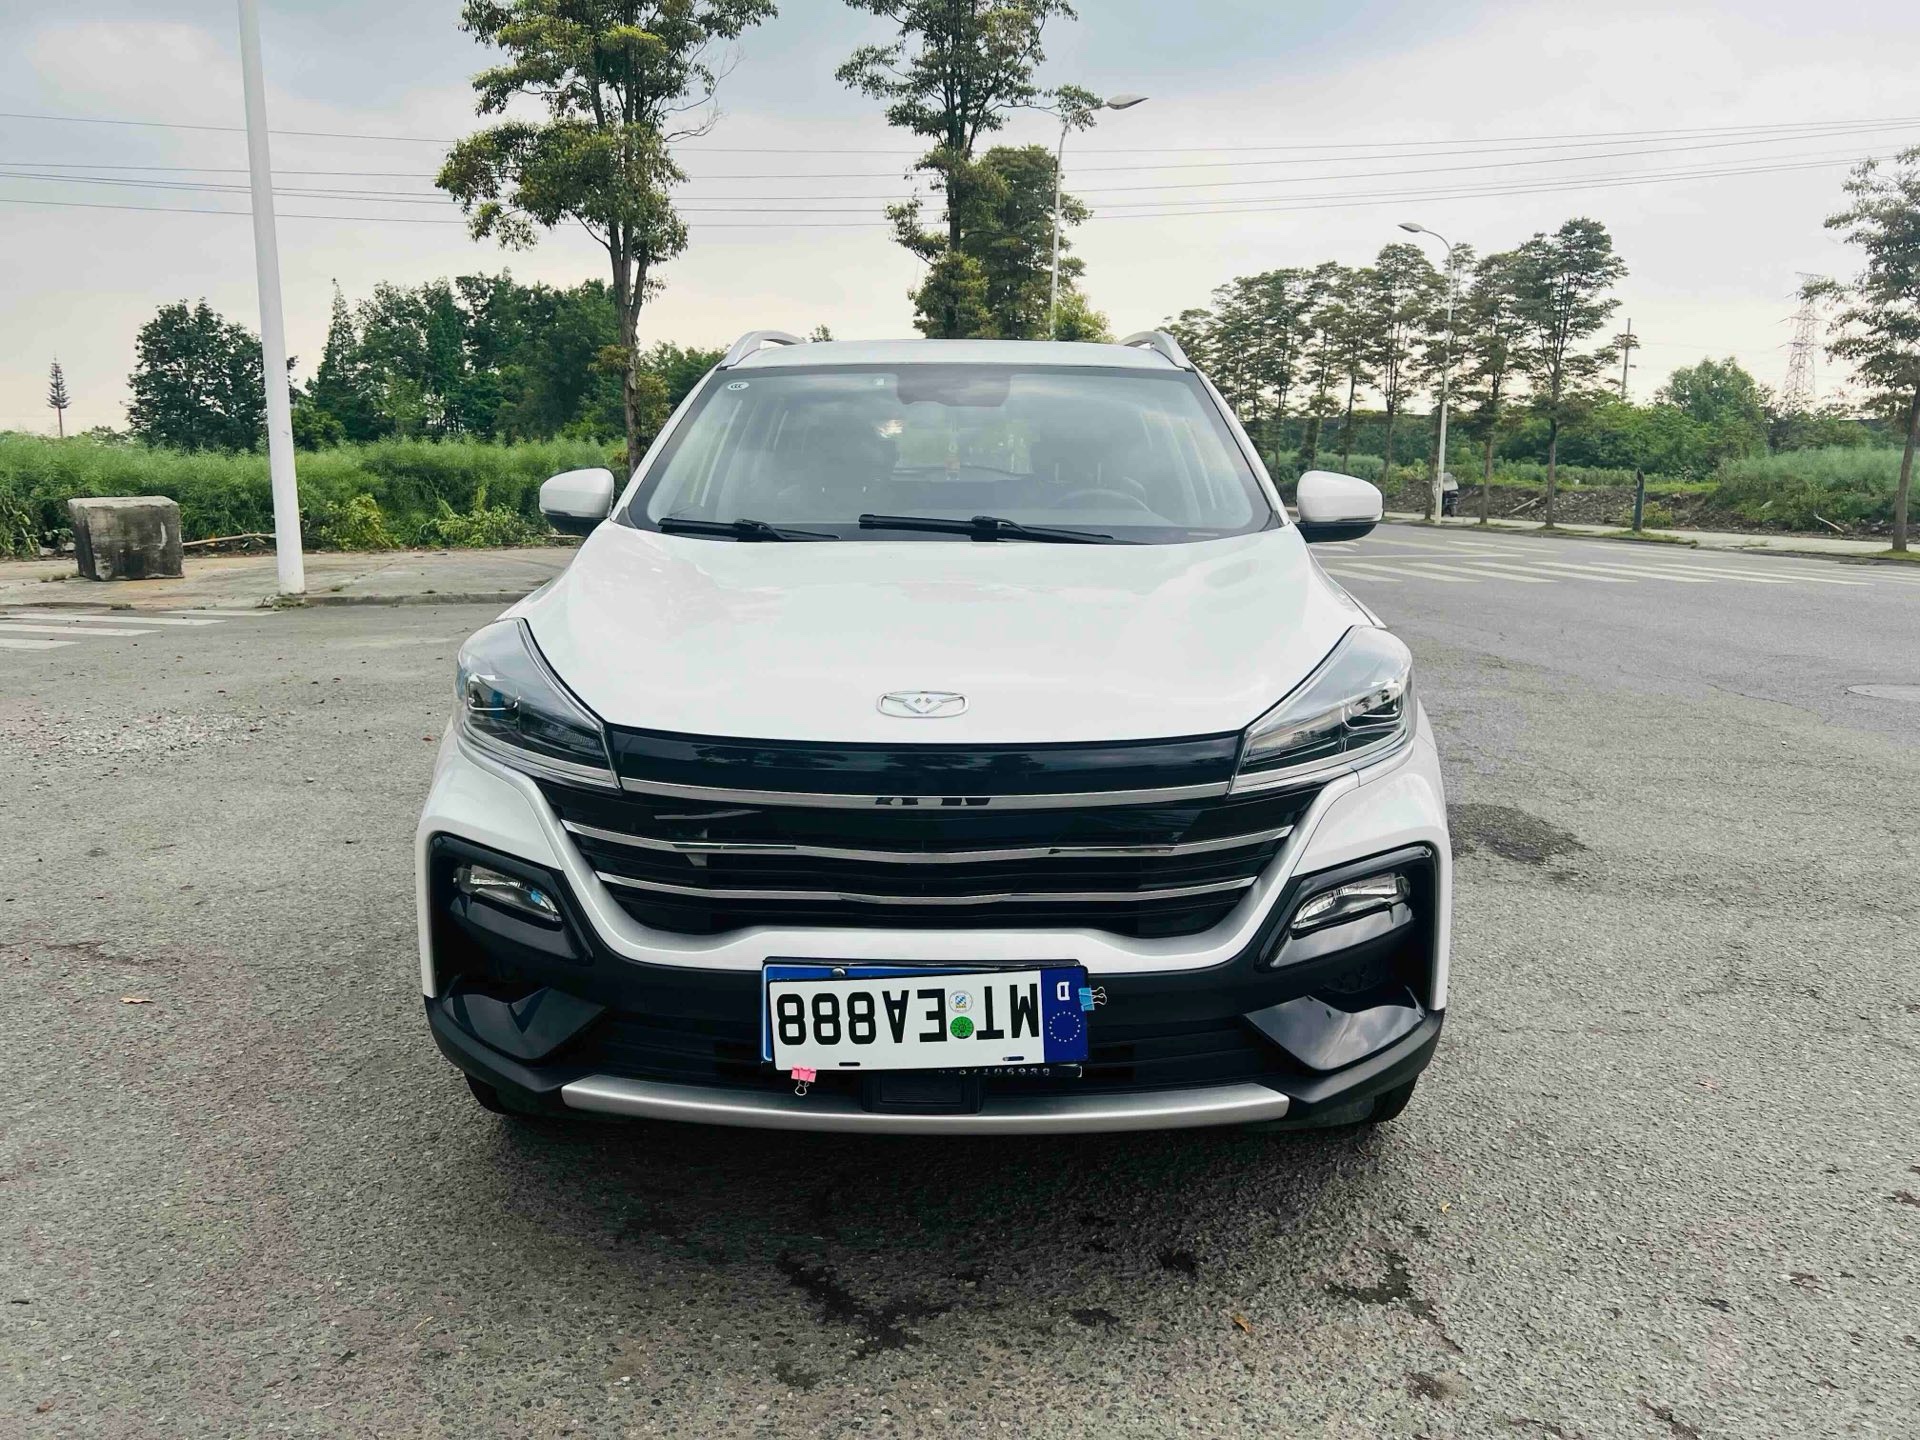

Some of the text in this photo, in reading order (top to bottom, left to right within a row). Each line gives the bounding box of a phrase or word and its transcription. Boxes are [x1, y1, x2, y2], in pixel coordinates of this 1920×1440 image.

[776, 988, 948, 1045] EA888
[976, 983, 1040, 1040] MT
[1056, 981, 1071, 999] D
